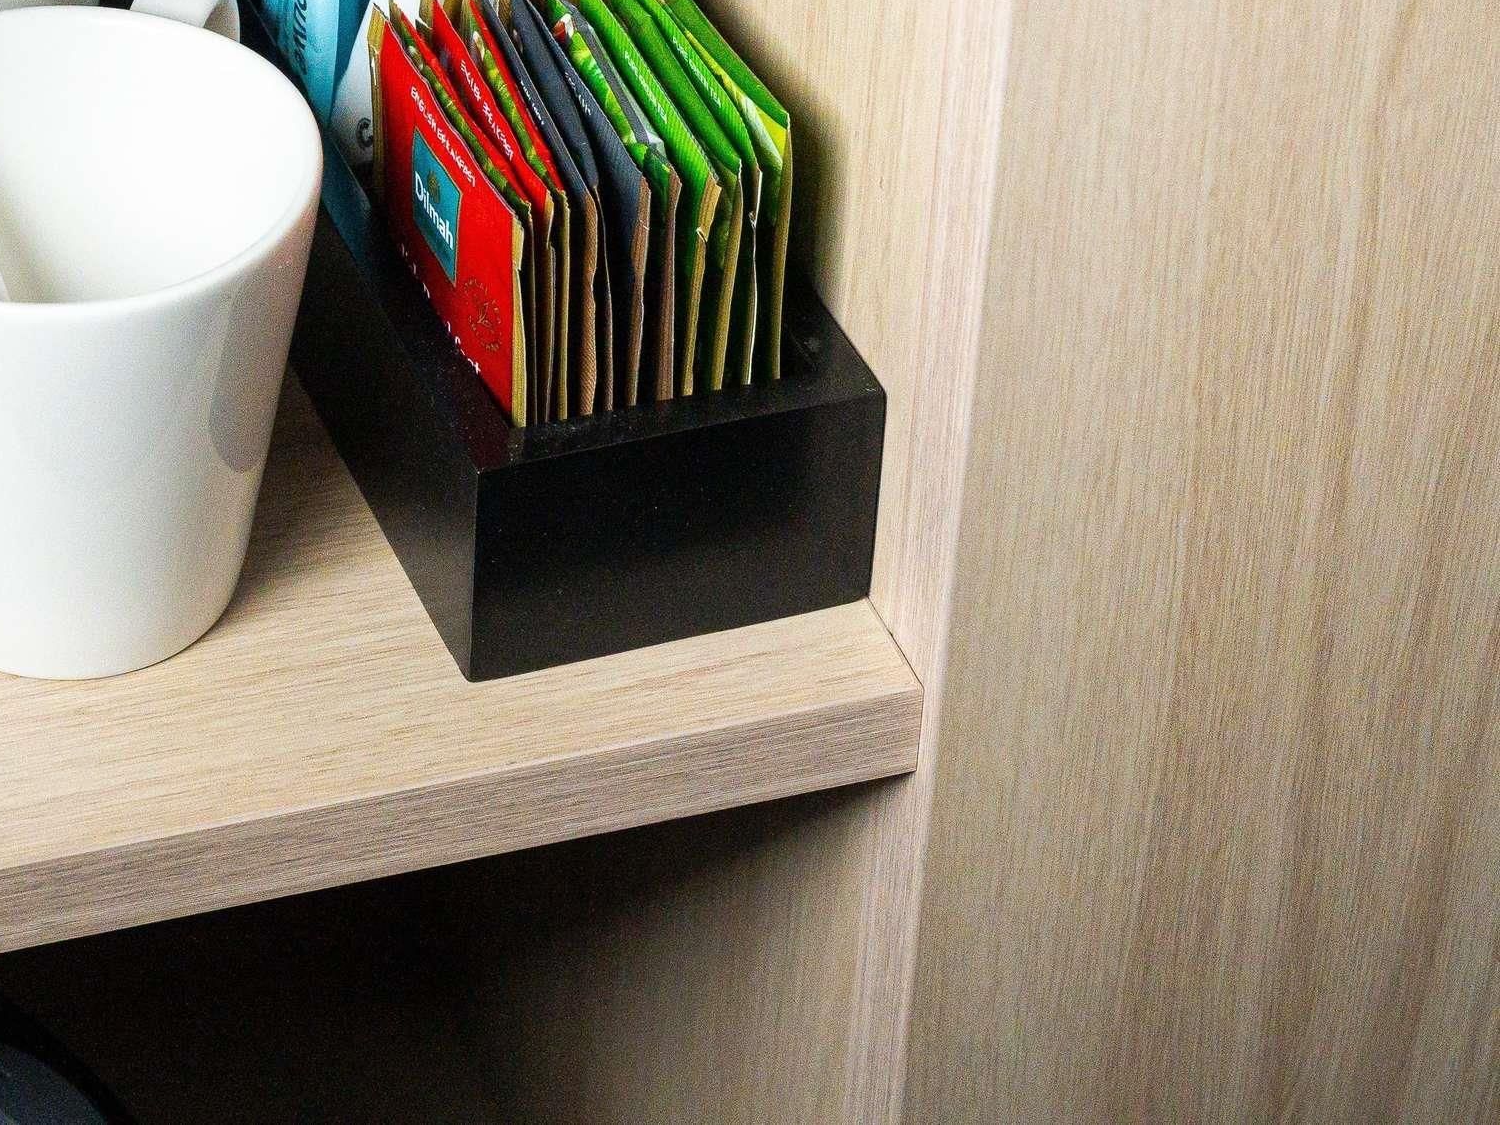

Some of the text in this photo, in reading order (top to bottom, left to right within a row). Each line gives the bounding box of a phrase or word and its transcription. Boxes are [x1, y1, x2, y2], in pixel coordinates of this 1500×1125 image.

[410, 86, 476, 188] ENGLISH BREAKFAST
[414, 170, 454, 250] Dilmah
